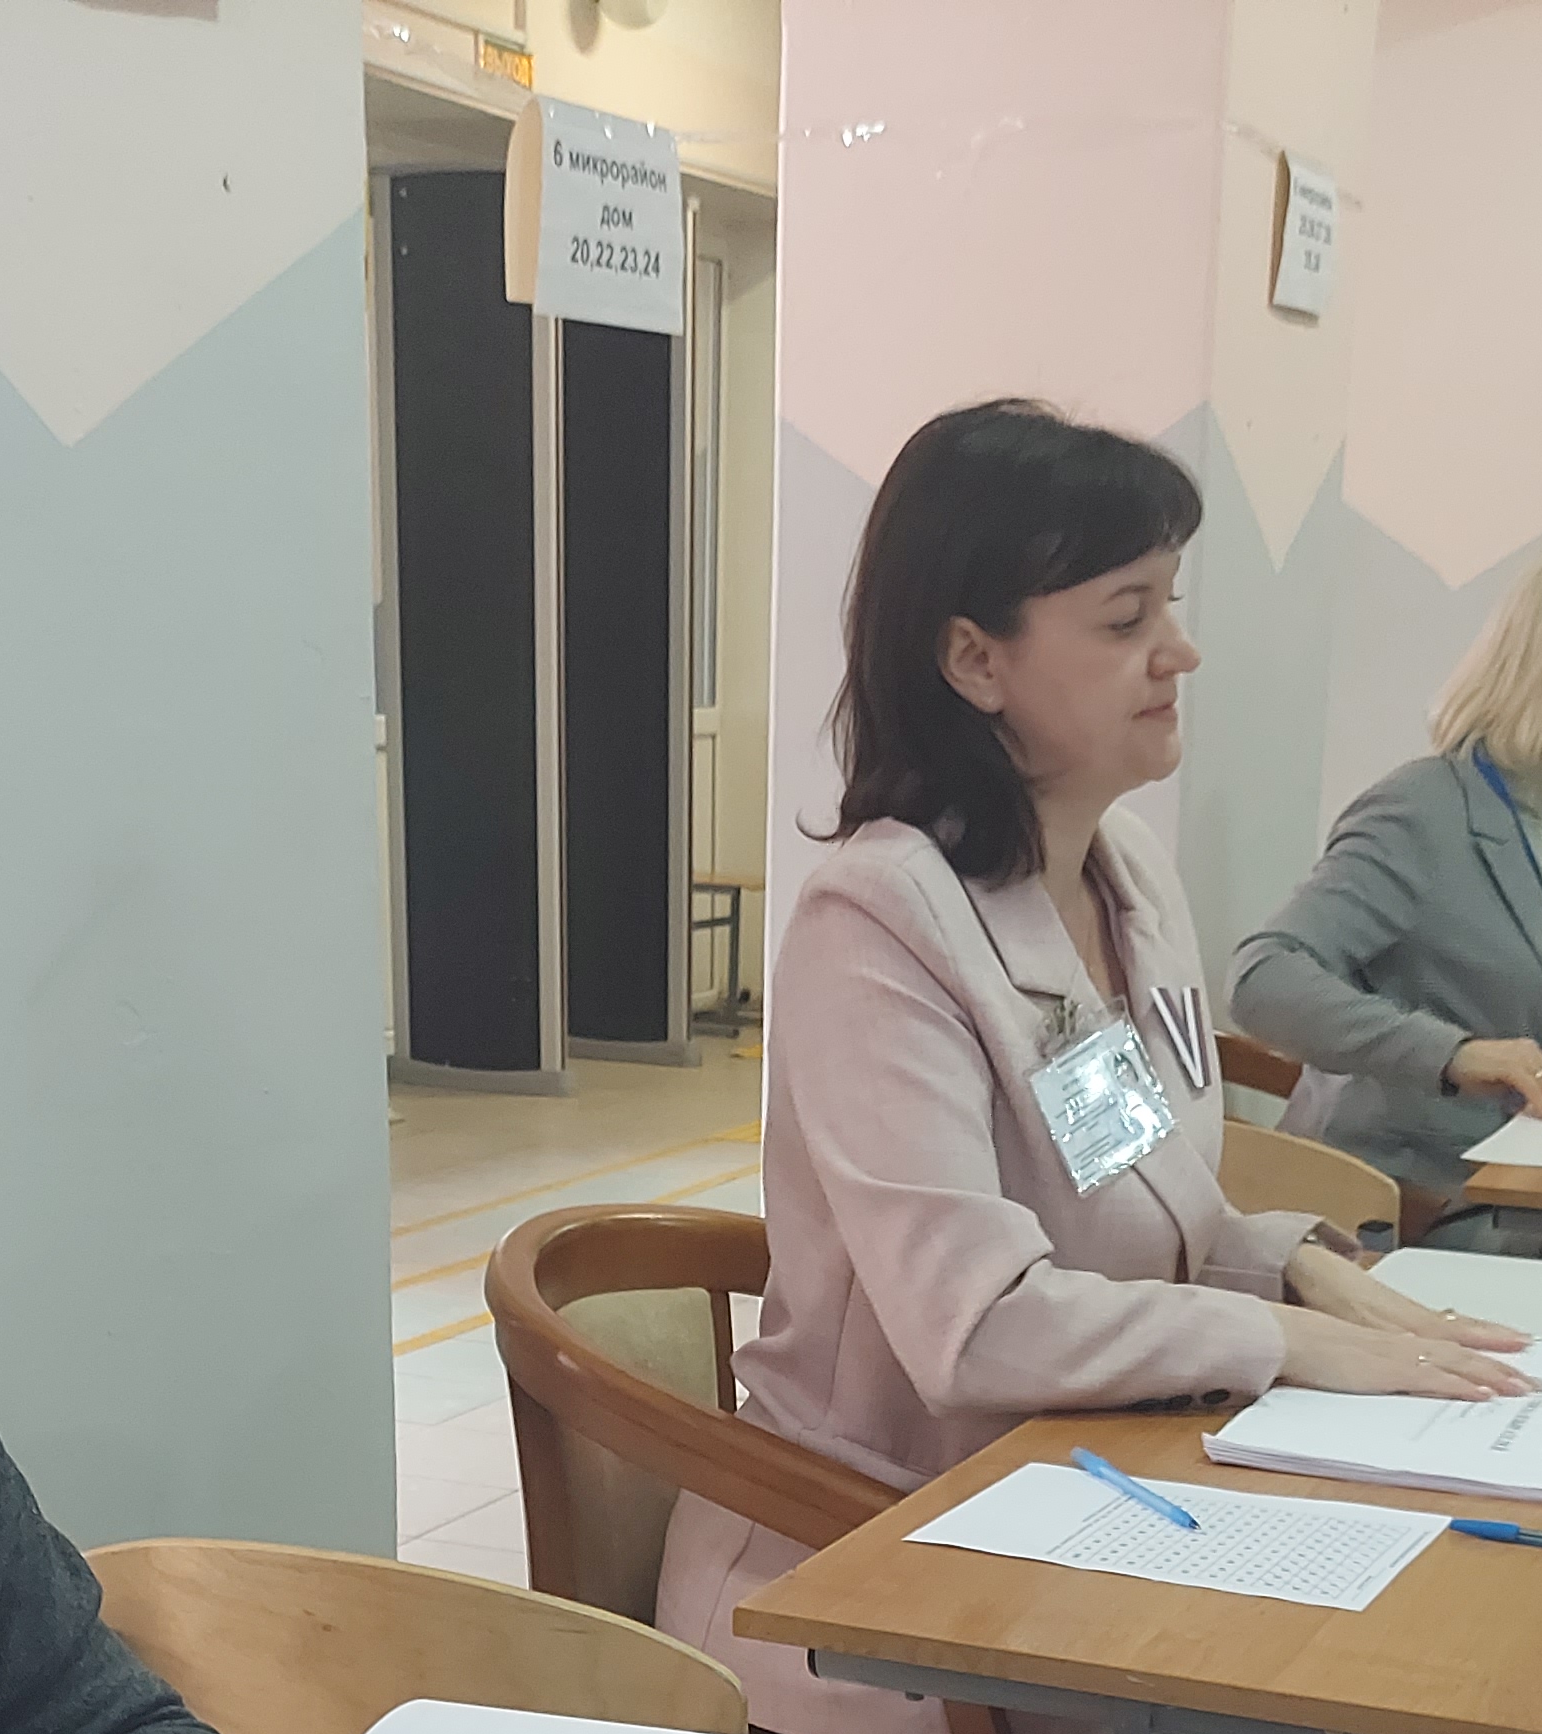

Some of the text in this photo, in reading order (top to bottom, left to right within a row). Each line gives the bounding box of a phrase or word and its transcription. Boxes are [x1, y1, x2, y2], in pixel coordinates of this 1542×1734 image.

[553, 140, 667, 192] 6 микрорайон
[600, 205, 633, 231] дом
[571, 236, 661, 279] 20,22,23,24
